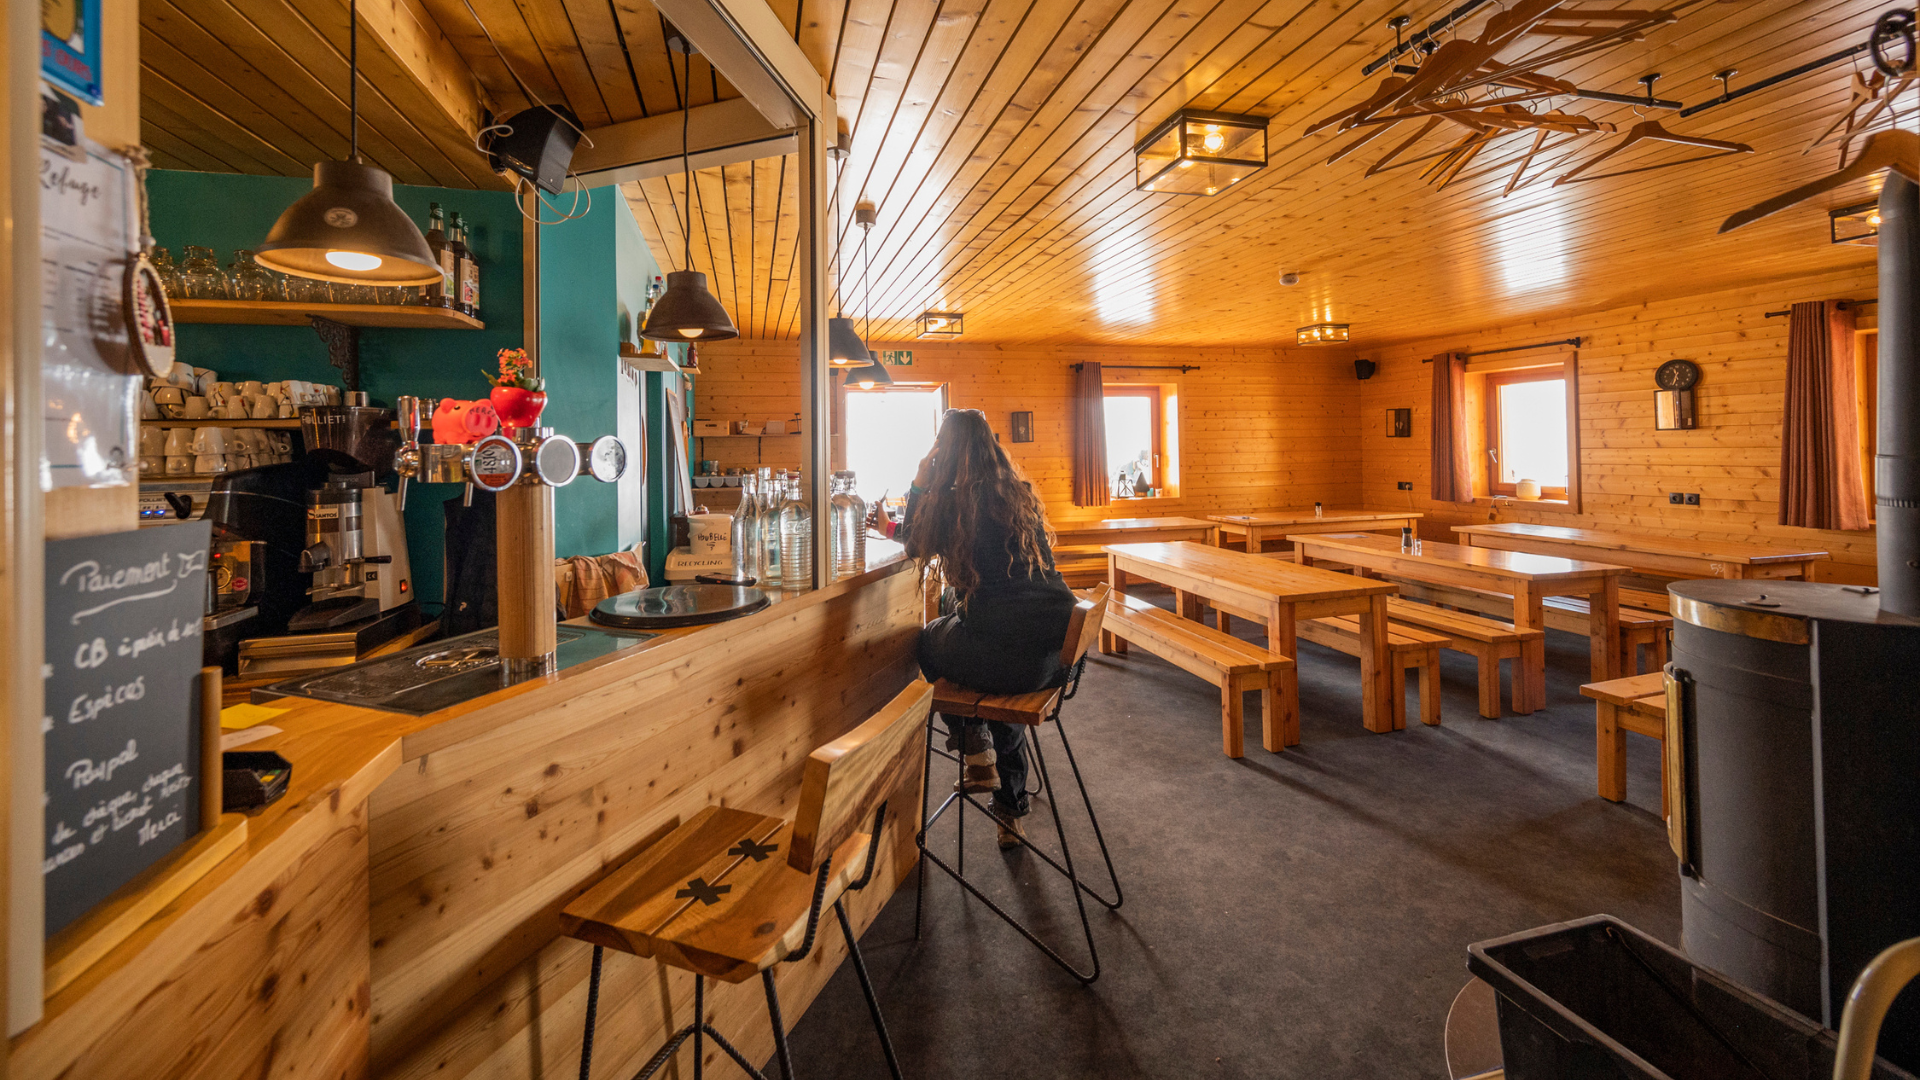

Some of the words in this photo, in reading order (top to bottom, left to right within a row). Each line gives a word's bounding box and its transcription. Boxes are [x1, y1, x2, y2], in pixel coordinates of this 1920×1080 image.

[301, 414, 342, 425] FOLLIET
[315, 510, 338, 519] SANTOS
[60, 552, 171, 593] Paiement
[74, 636, 109, 669] CB
